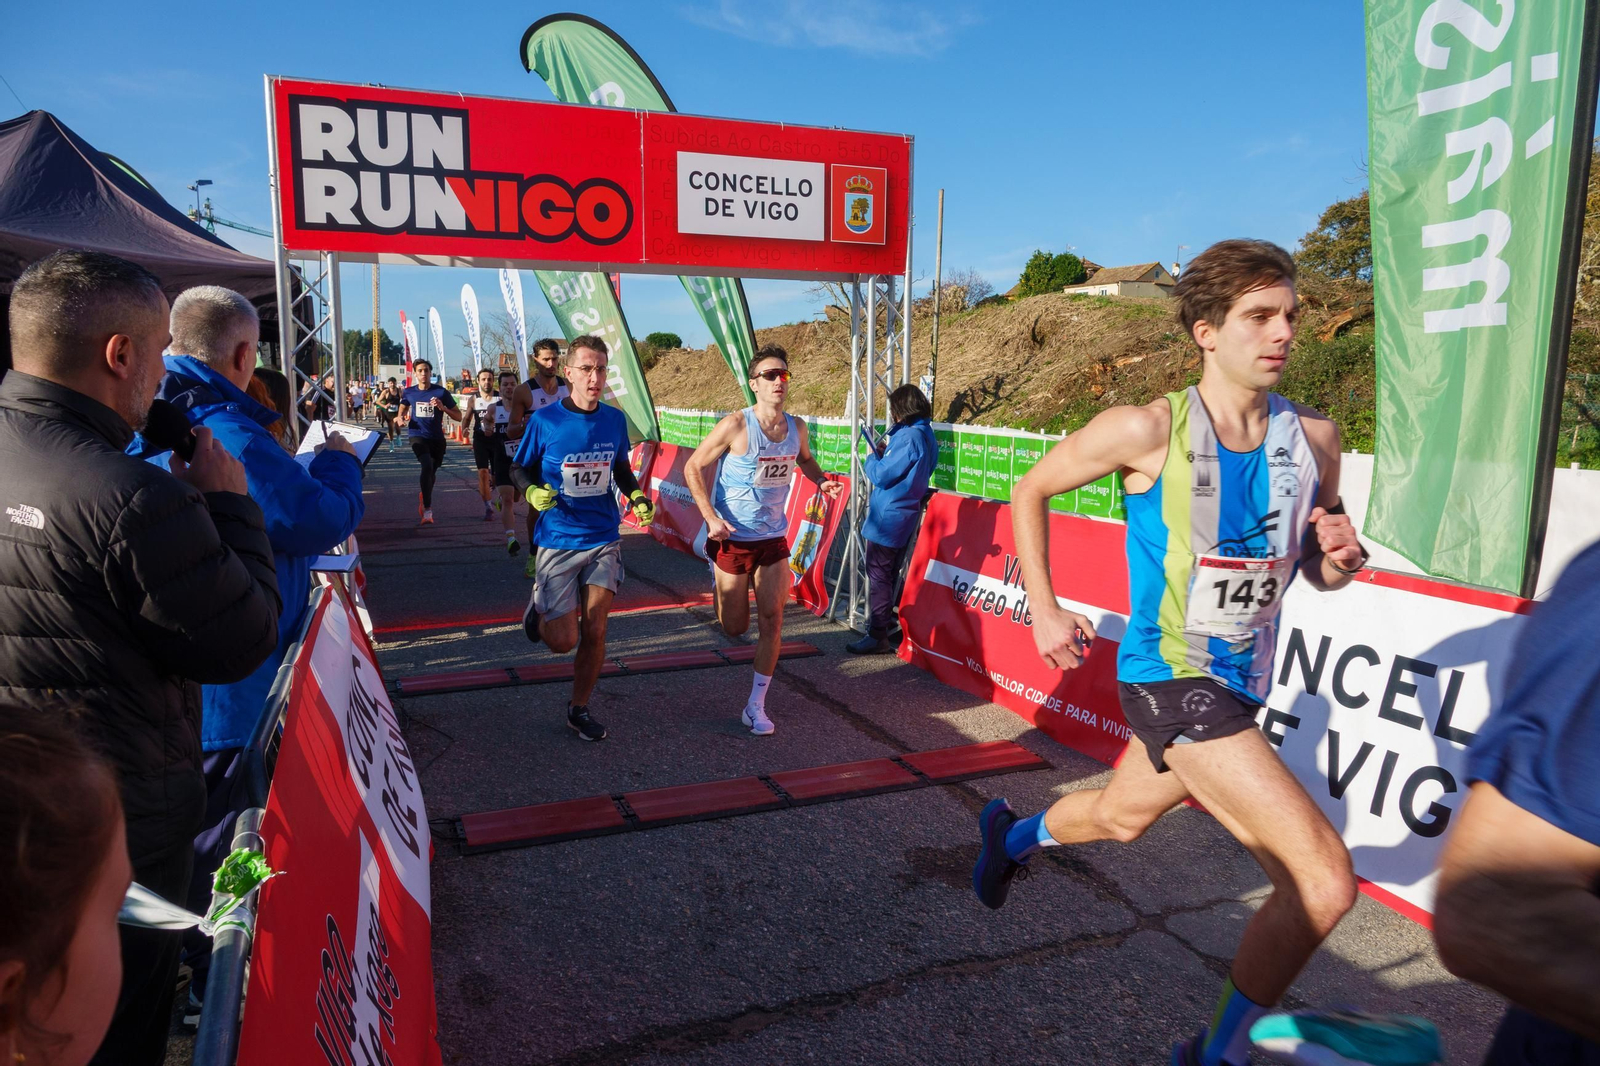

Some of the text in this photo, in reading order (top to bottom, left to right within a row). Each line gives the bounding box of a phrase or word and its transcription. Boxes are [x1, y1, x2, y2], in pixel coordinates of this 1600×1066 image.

[298, 103, 464, 171] RUN
[758, 135, 822, 156] Castro
[688, 170, 813, 198] CONCELLO
[704, 197, 799, 221] DE VIGO
[572, 470, 602, 487] 147
[764, 464, 788, 478] 122
[5, 506, 32, 520] NORTH
[19, 503, 35, 513] THE
[10, 515, 31, 526] FACE
[952, 574, 1007, 618] terreo
[1212, 577, 1278, 609] 143
[990, 669, 1025, 696] MELLOR
[1025, 687, 1063, 714] CIDADE
[1064, 703, 1098, 728] PARA
[1102, 716, 1134, 742] VIVIR
